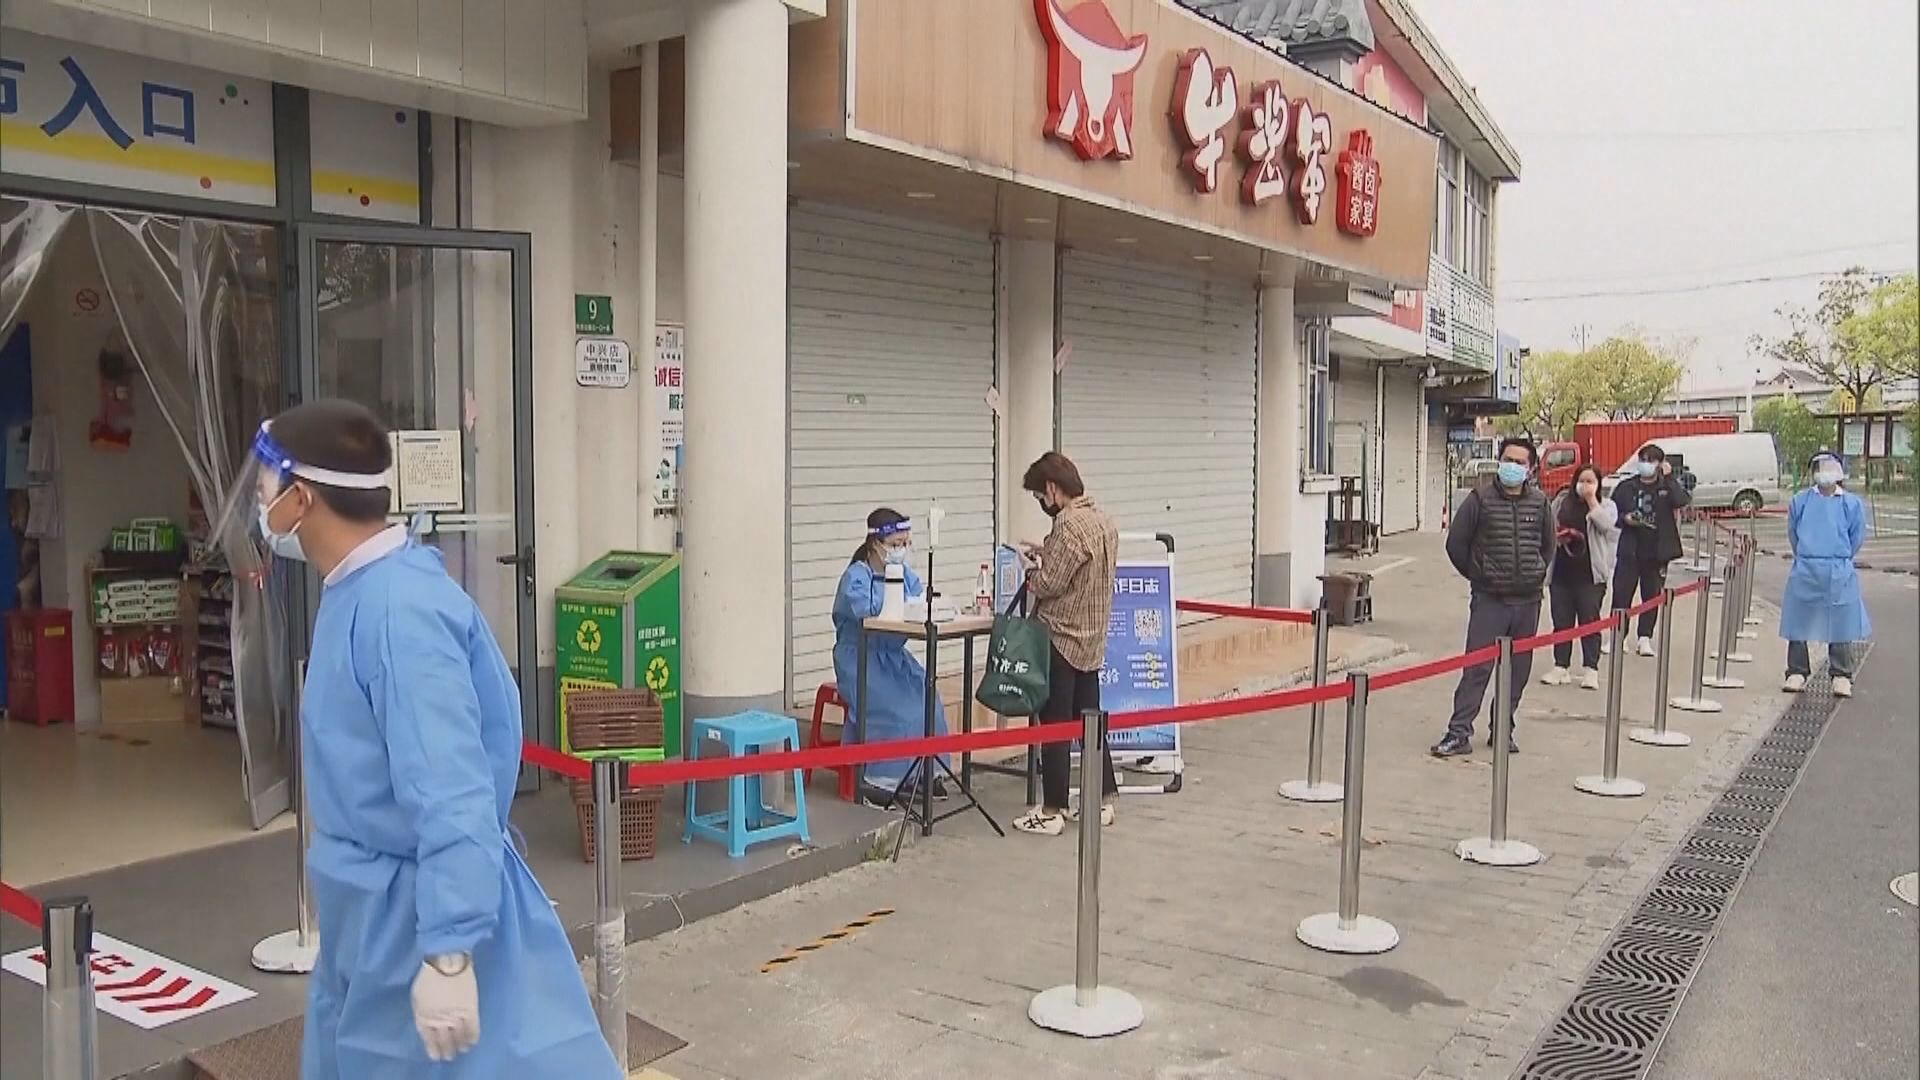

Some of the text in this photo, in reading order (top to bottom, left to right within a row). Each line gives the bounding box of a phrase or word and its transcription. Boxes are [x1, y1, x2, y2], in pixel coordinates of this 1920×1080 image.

[588, 299, 598, 320] 9
[655, 366, 684, 387] 诚信
[669, 394, 684, 411] 服
